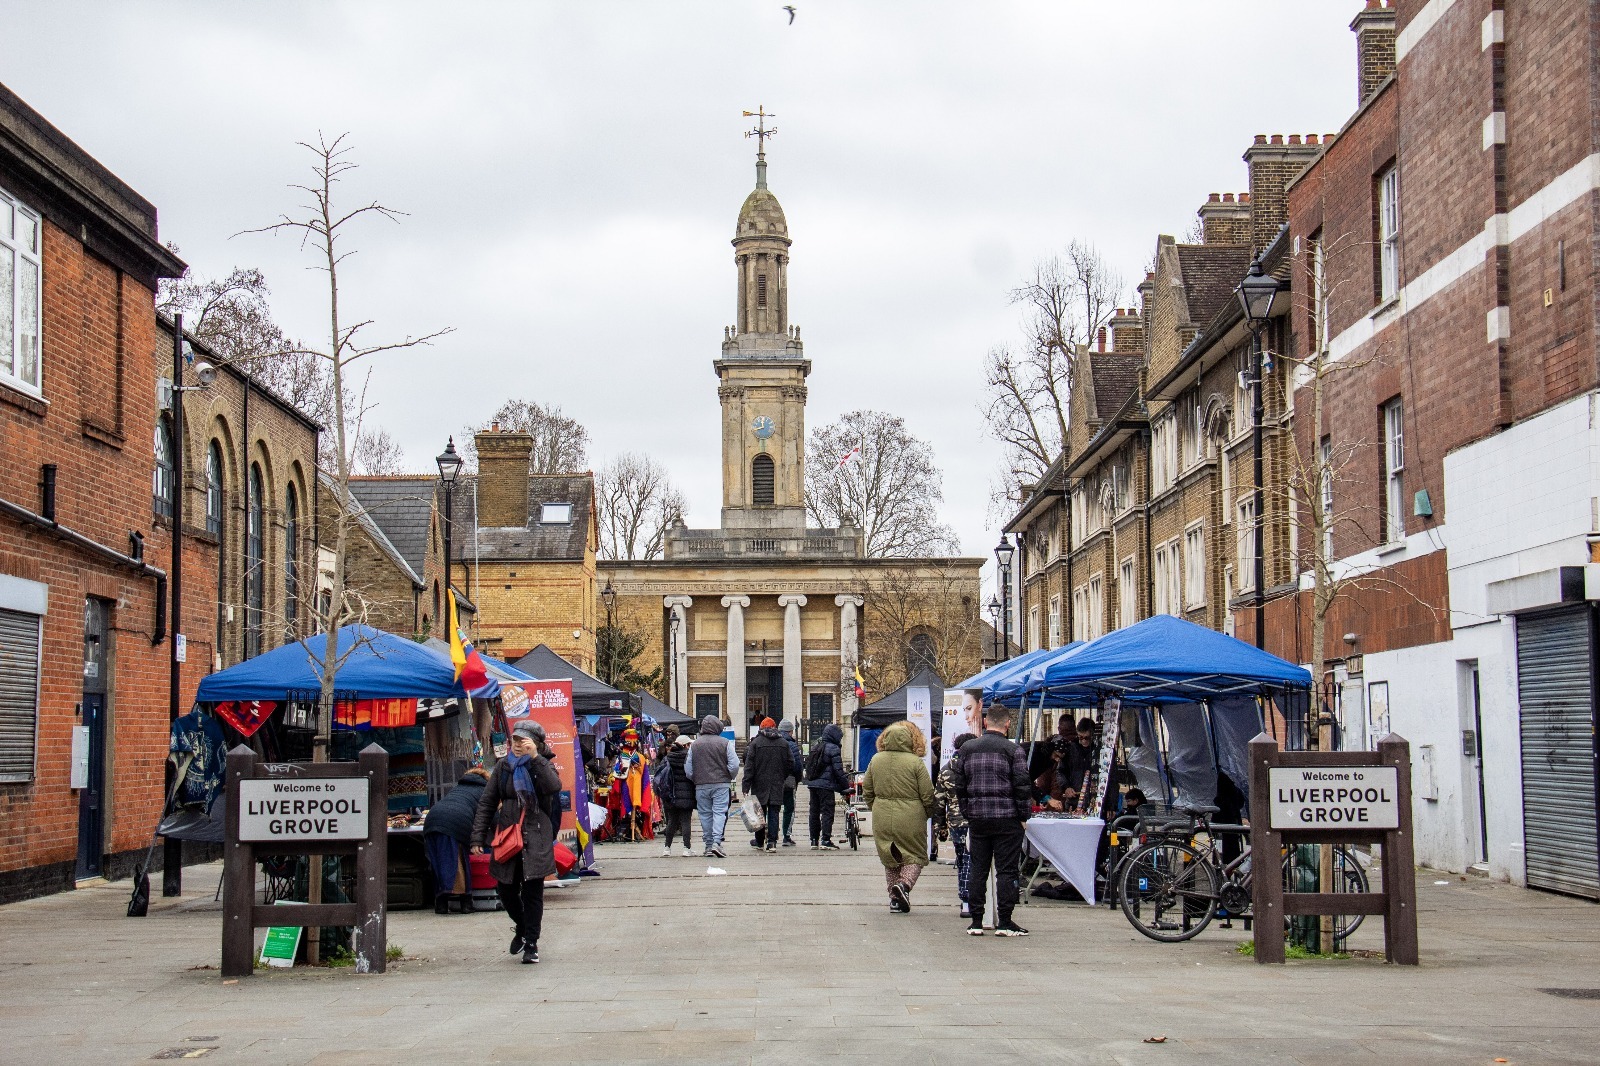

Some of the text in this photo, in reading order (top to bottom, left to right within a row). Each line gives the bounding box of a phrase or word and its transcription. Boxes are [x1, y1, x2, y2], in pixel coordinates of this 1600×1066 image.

[1302, 772, 1364, 781] Welcome to
[273, 783, 336, 792] Welcome to
[1278, 788, 1391, 803] LIVERPOOL
[248, 799, 361, 815] LIVERPOOL
[1300, 807, 1369, 822] GROVE
[269, 818, 339, 834] GROVE
